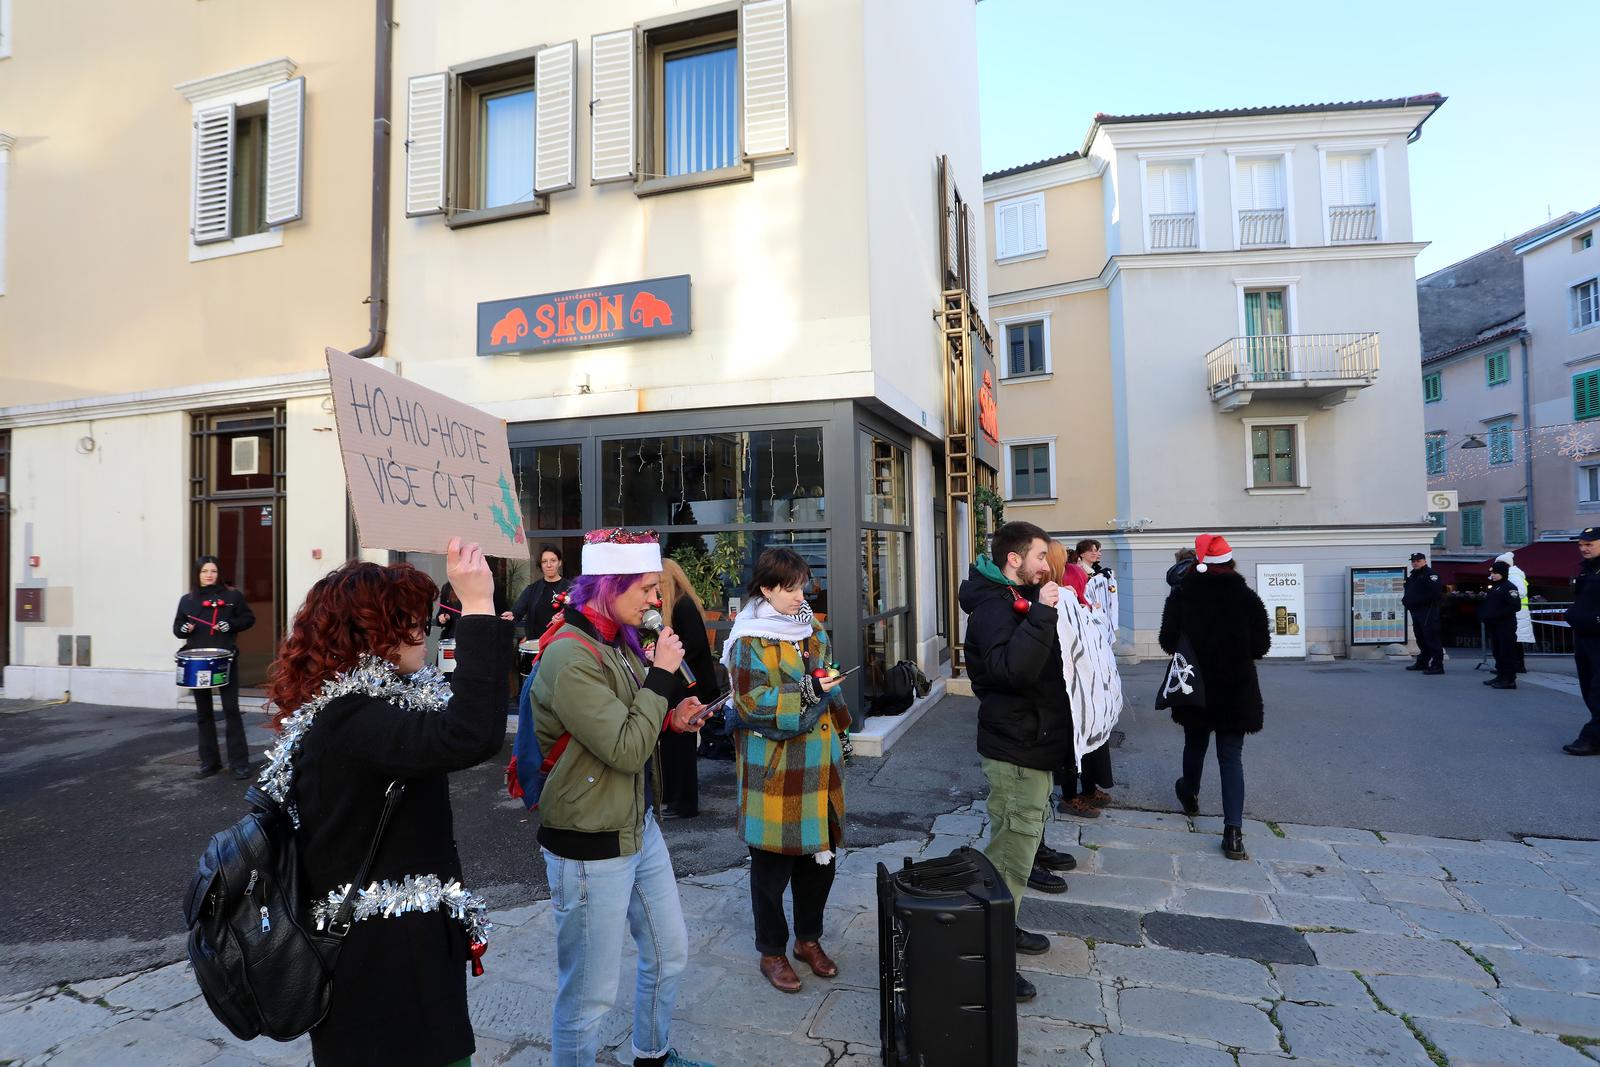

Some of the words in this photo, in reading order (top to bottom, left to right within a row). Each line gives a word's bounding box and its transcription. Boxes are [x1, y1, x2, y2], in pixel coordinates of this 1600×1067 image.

[533, 293, 624, 339] SLON
[350, 377, 490, 465] HO-HO-HOTE
[362, 446, 427, 508] VIŠE
